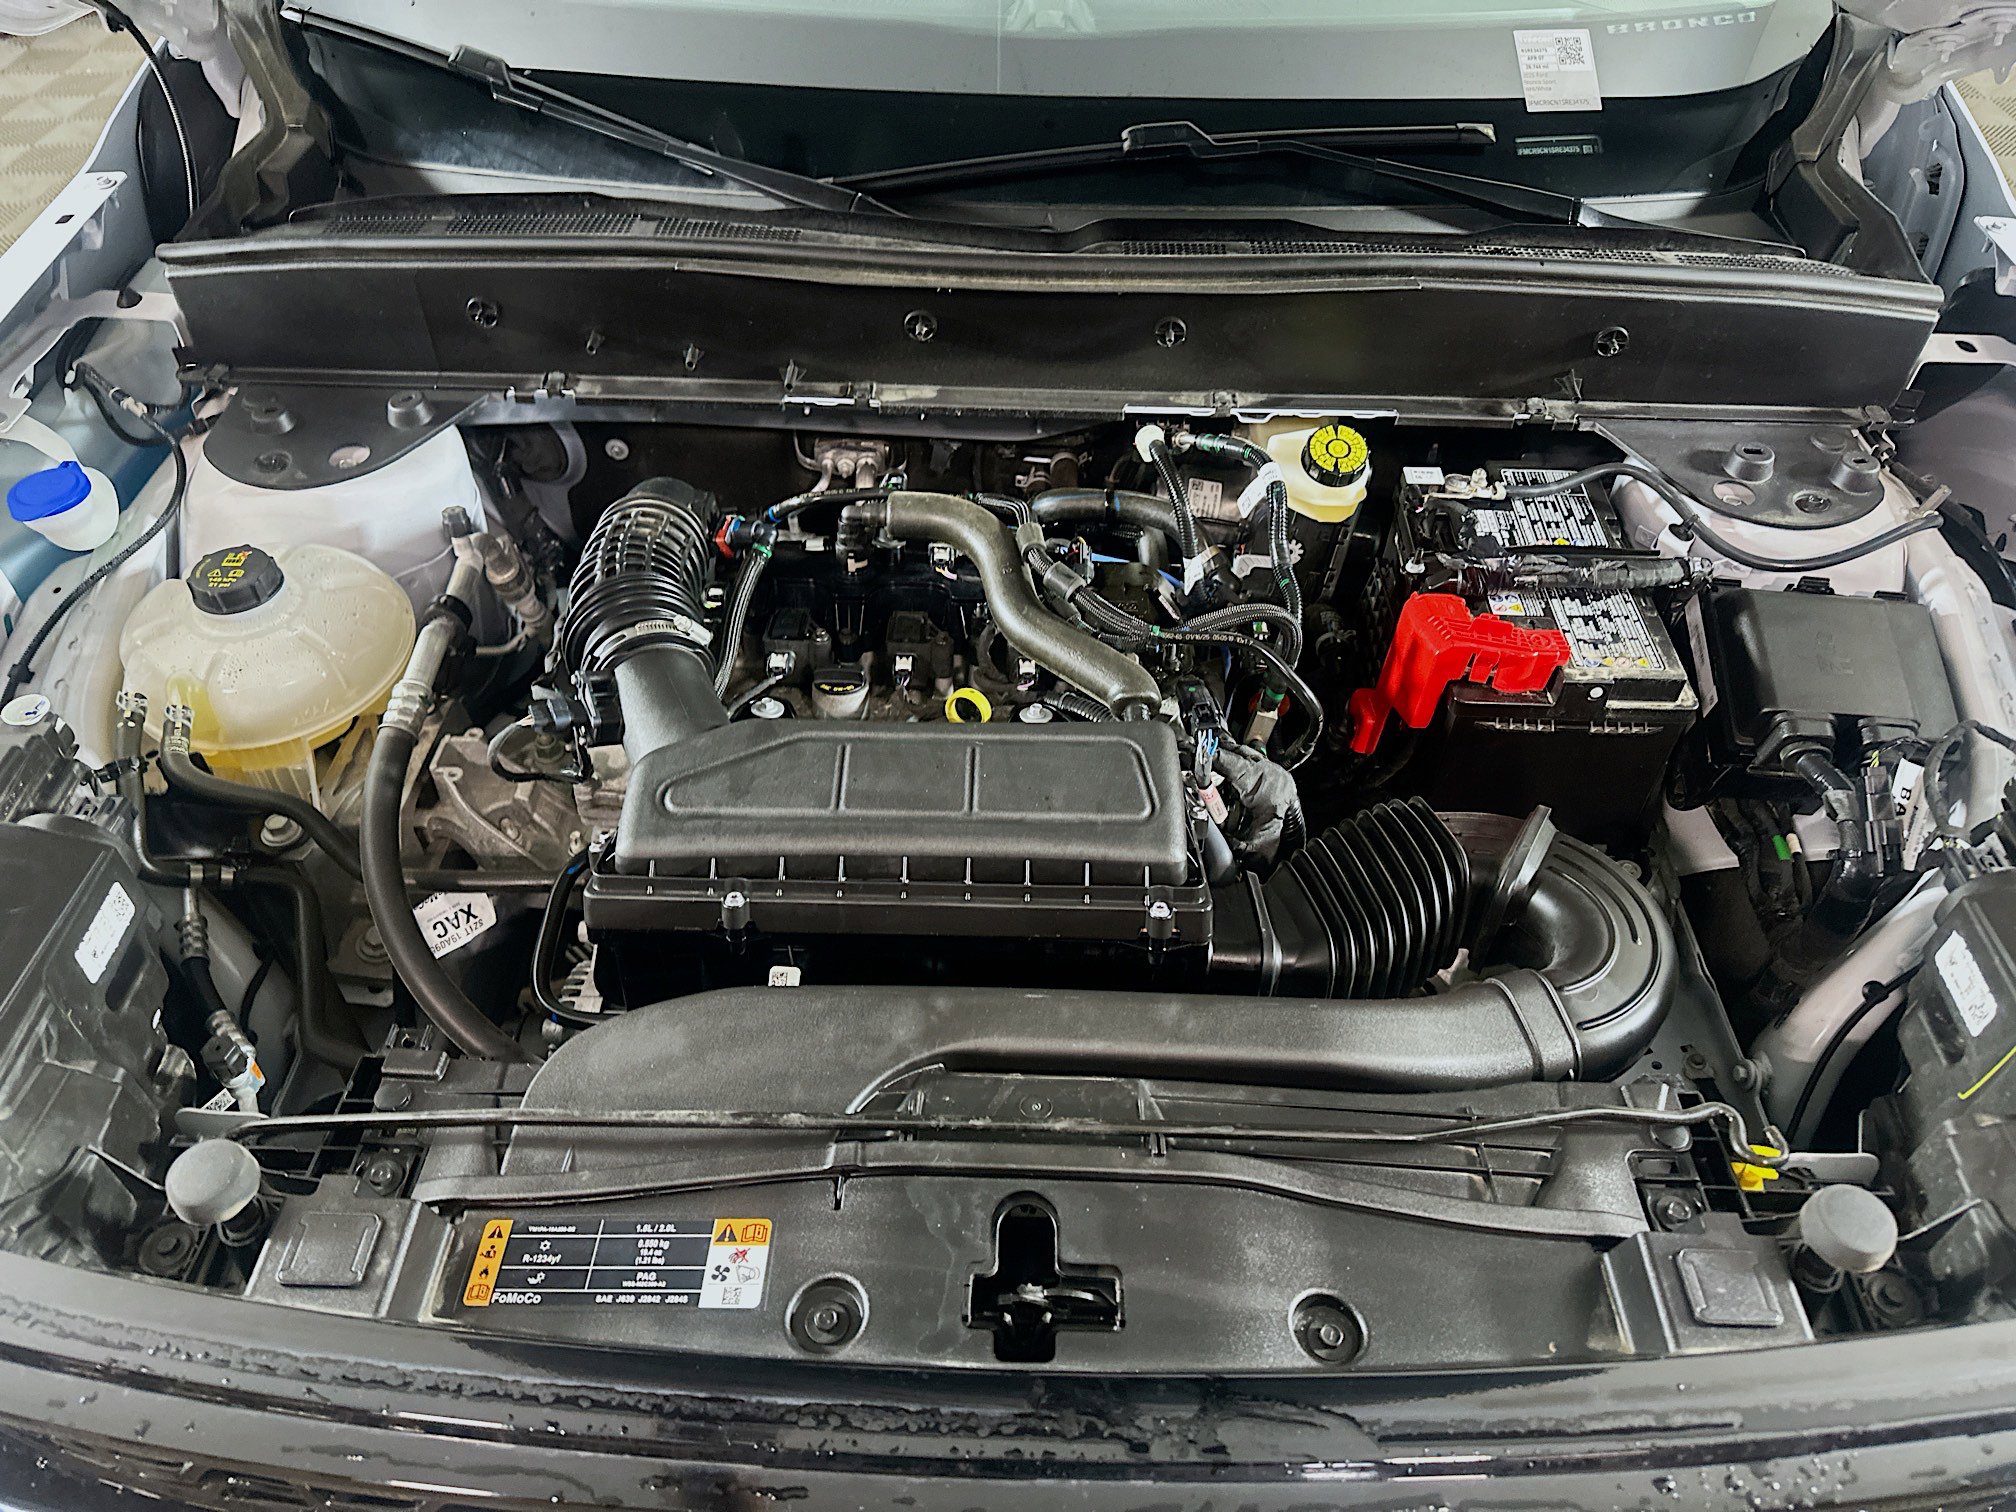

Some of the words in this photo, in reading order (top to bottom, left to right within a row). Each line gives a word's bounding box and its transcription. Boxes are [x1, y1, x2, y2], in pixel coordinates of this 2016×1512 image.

[1607, 11, 1756, 34] BRONCO
[432, 902, 479, 939] XAC
[659, 1238, 670, 1250] kg
[522, 1253, 562, 1265] R-1234yf
[636, 1271, 657, 1281] PAG
[491, 1292, 542, 1304] FoMoCo
[595, 1294, 613, 1304] SAE
